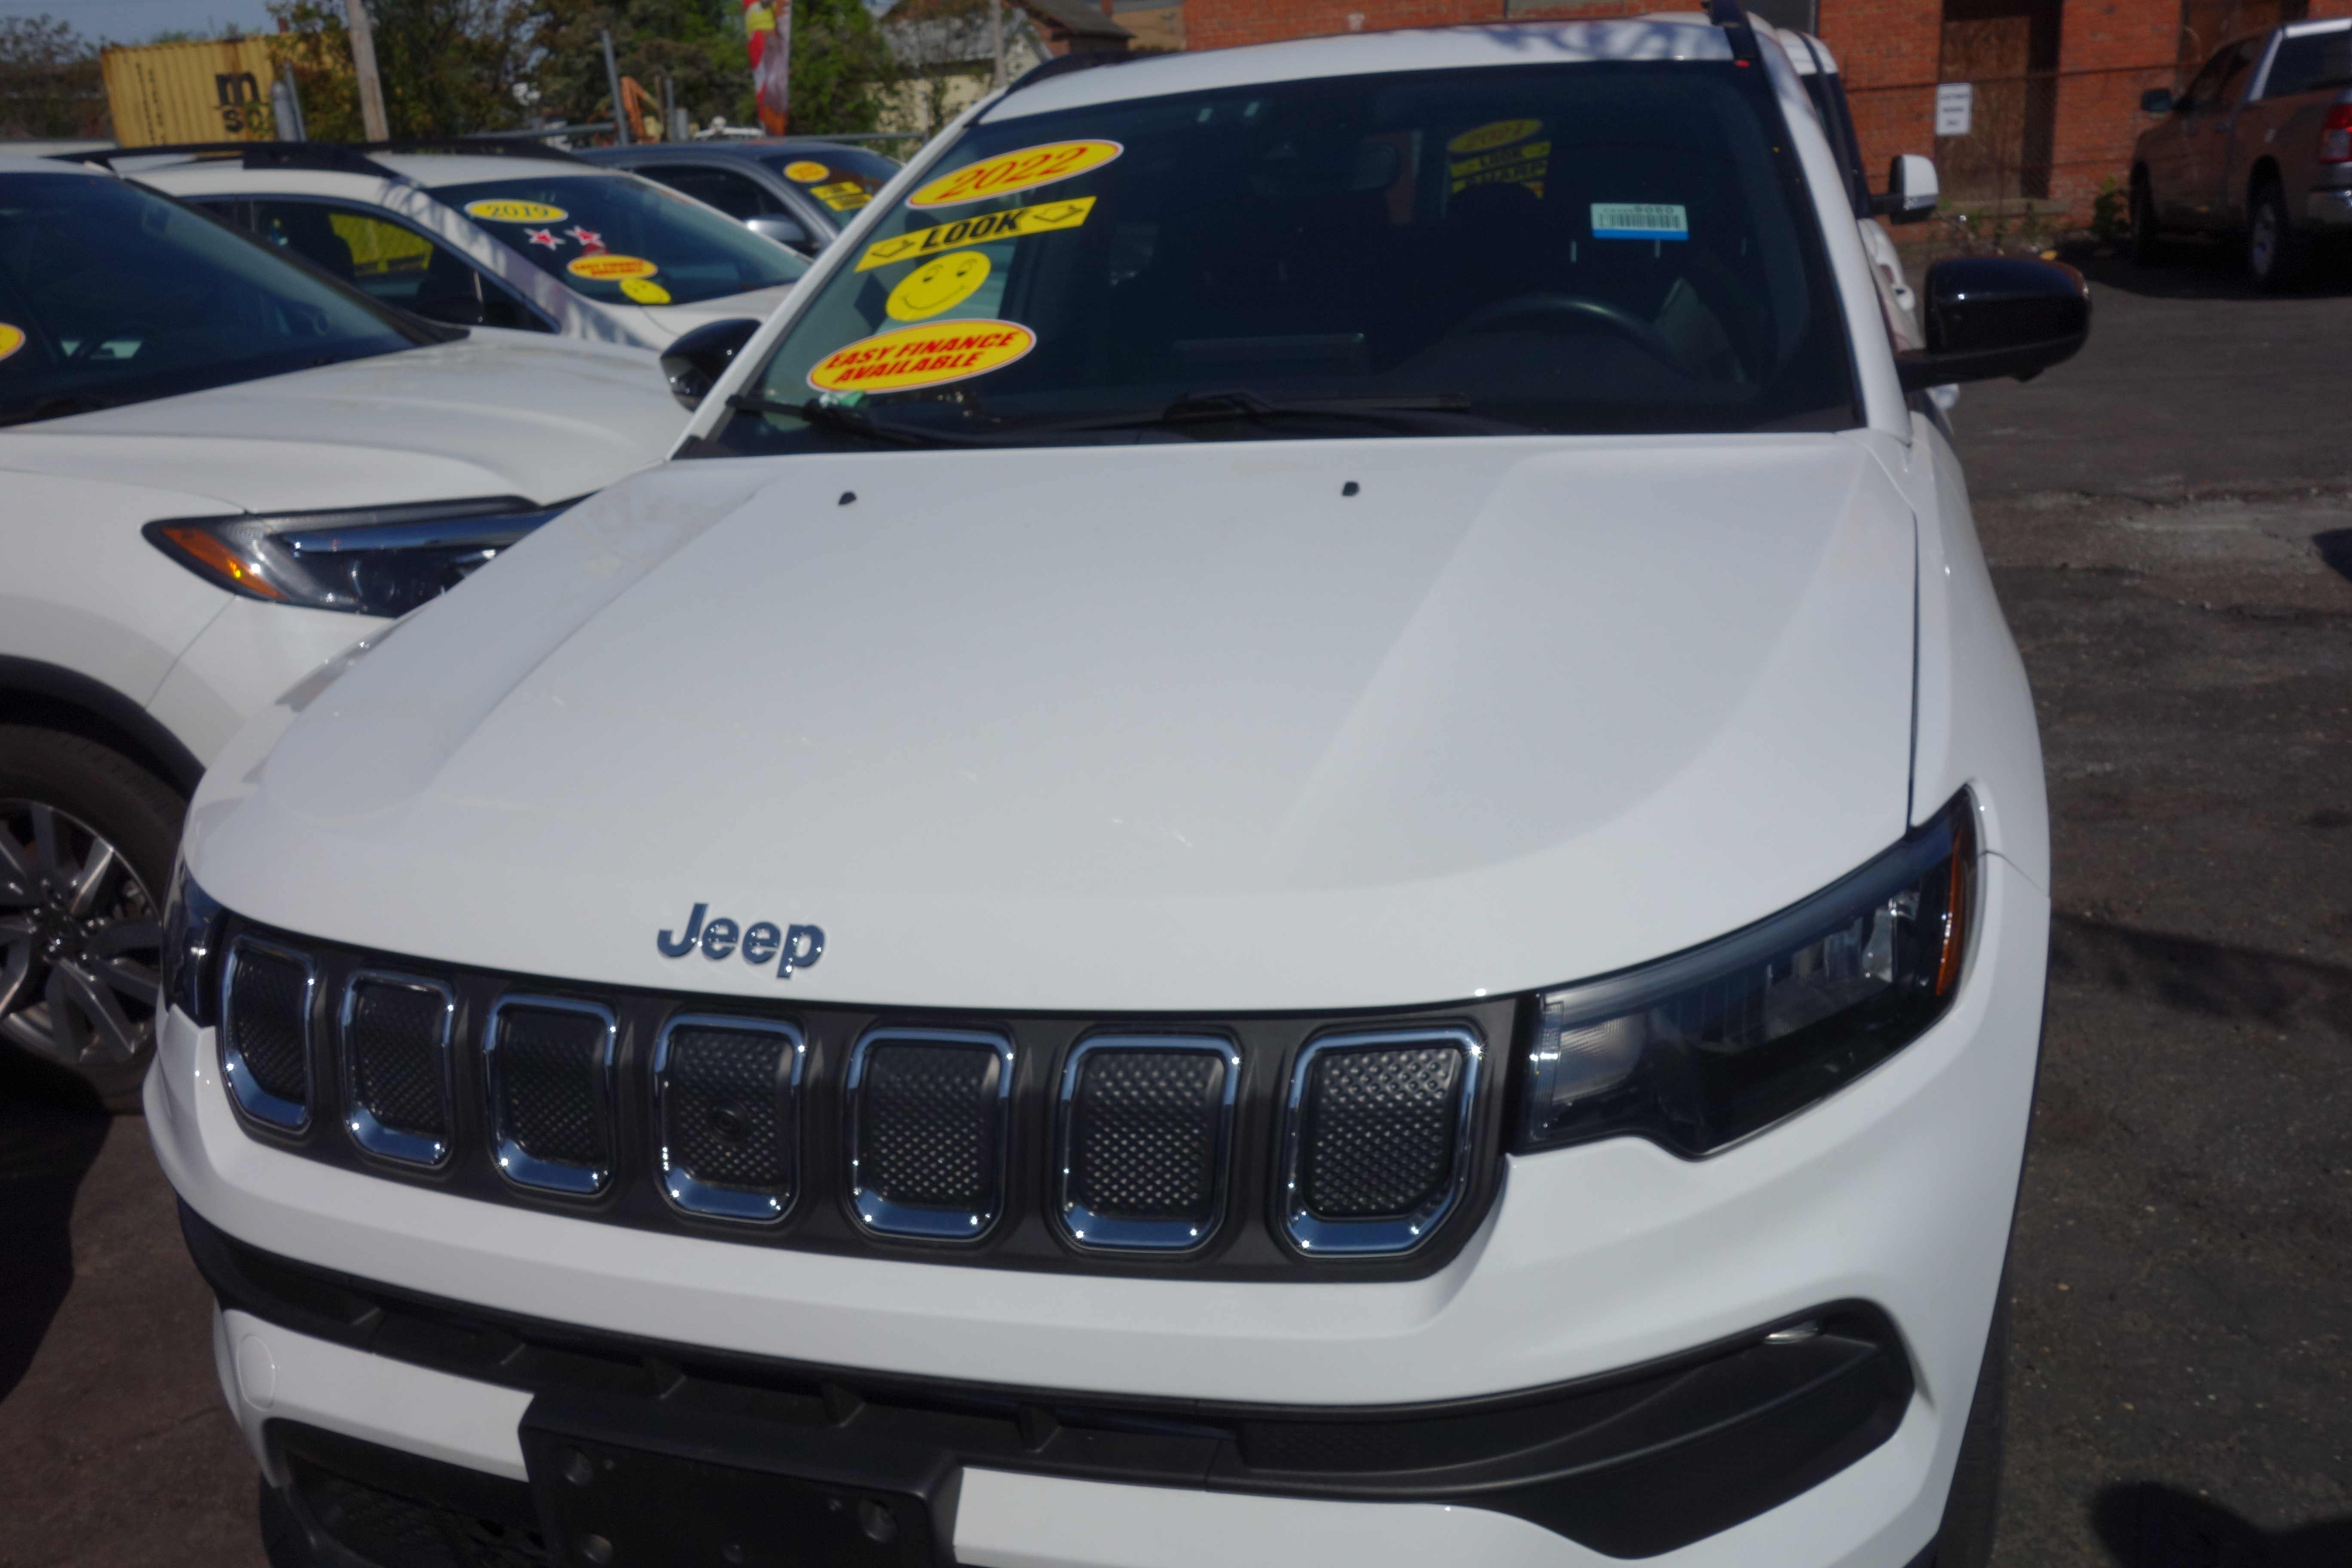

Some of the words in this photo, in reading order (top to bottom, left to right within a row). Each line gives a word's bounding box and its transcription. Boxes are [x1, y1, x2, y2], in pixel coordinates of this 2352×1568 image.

[934, 147, 1088, 201] 2022
[919, 208, 1030, 251] LOOK
[825, 344, 897, 370] EASY
[894, 331, 1019, 358] FINANCE
[833, 351, 984, 384] AVAILABLE
[657, 902, 825, 979] Jeep
